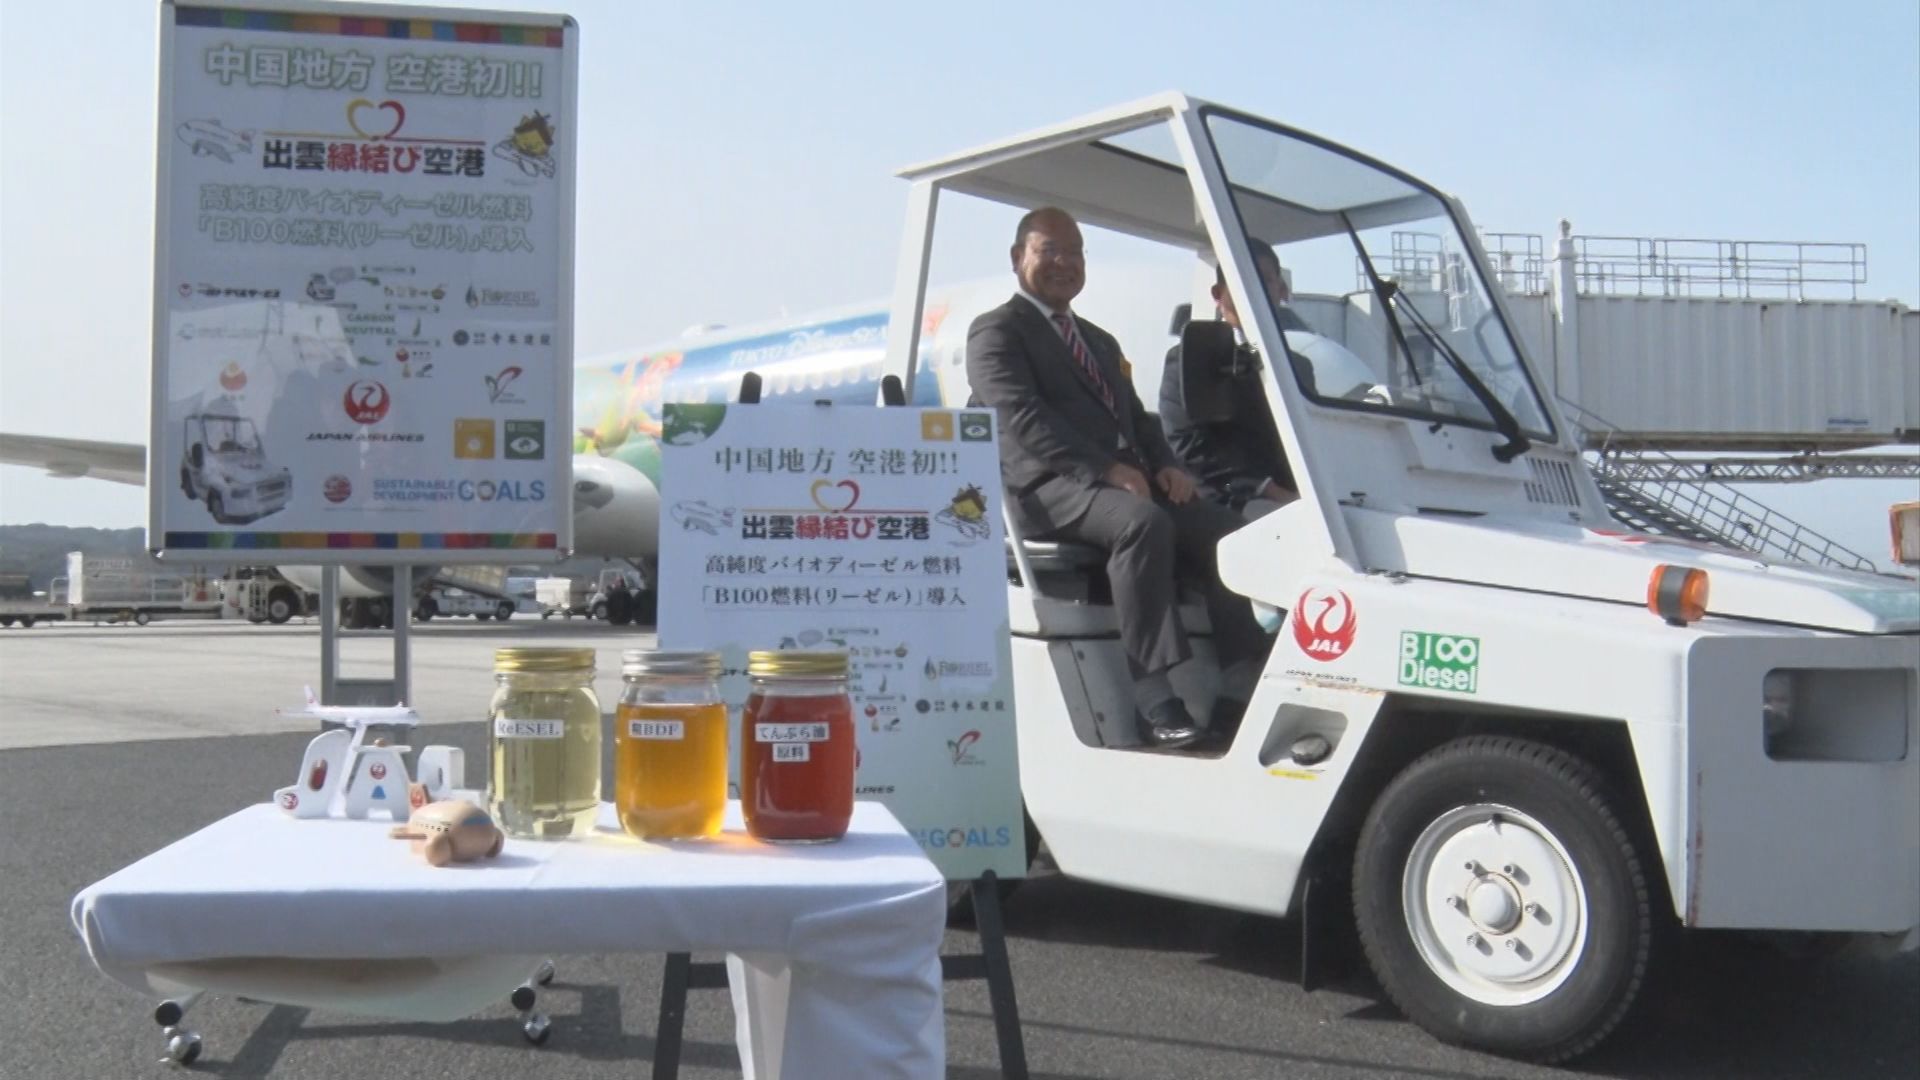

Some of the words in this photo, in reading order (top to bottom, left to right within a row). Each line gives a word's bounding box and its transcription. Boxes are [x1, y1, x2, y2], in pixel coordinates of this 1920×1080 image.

[206, 44, 373, 91] 中国地方
[387, 55, 543, 98] 空港初!!
[263, 139, 486, 178] 出雲縁結び空港
[199, 184, 533, 221] 高純度バイオディーゼル燃料
[305, 432, 353, 442] JAPAN
[715, 446, 836, 476] 中国地方
[849, 449, 959, 476] 空港初!!
[373, 479, 456, 490] SUSTAINABLE
[373, 490, 456, 501] DEVELOPMENT
[458, 479, 545, 502] GOALS
[742, 516, 930, 541] 出雲縁結び空港
[705, 555, 962, 576] 高純度バイオディーゼル燃料
[1307, 638, 1343, 654] JAL
[1400, 658, 1478, 692] Diesel
[929, 827, 1011, 848] GOALS
